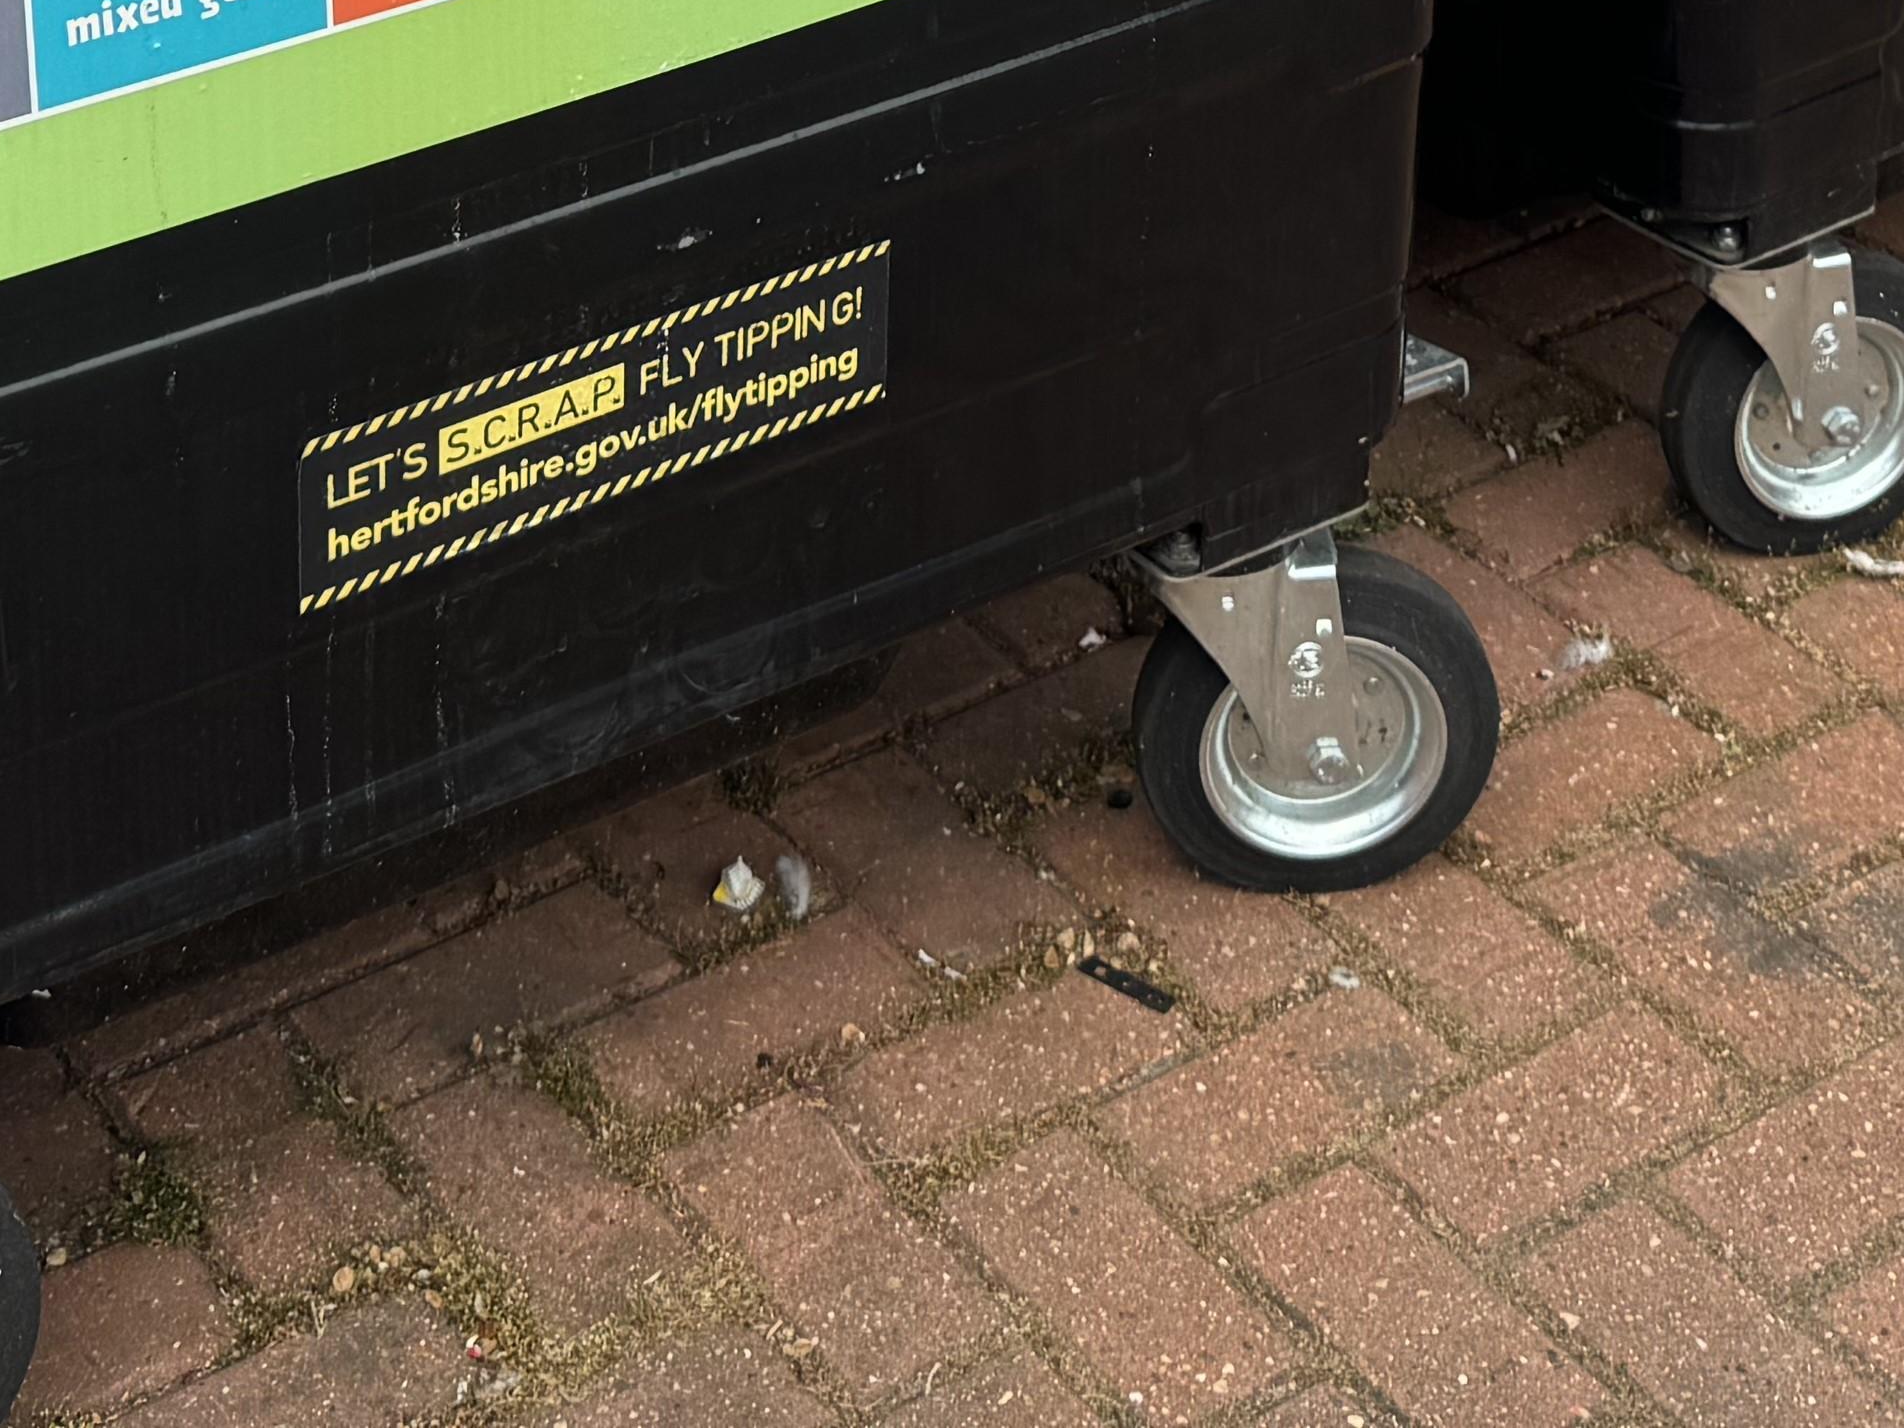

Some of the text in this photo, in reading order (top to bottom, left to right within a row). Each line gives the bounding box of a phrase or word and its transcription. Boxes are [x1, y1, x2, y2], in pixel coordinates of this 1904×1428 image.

[327, 443, 428, 509] LET'S
[640, 341, 705, 396] FLY
[714, 286, 863, 367] TIPPING!
[328, 348, 858, 561] hertfordshire.gov.uk/flytipping
